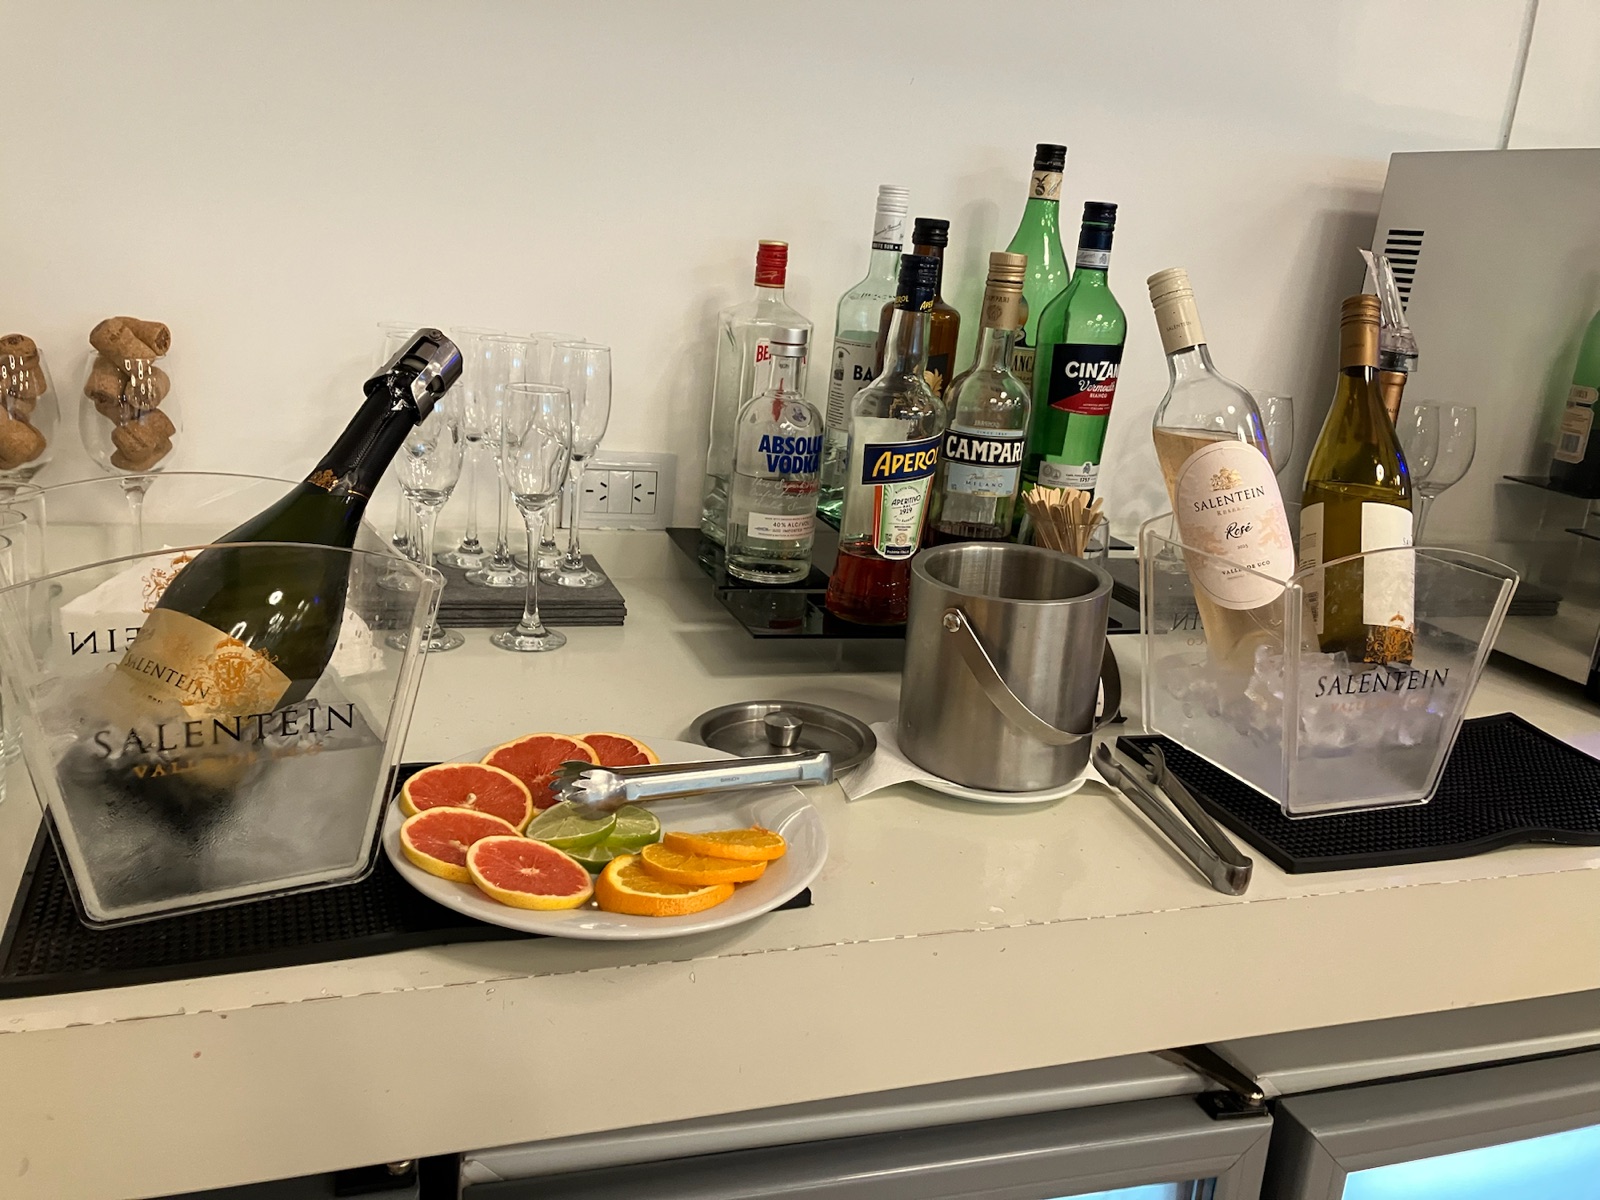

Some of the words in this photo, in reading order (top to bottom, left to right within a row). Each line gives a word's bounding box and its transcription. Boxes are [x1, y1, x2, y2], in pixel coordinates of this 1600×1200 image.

[1065, 361, 1121, 381] CINZAN
[758, 434, 823, 455] ABSOLU
[946, 435, 1025, 463] CAMPARI
[766, 454, 819, 473] VODKA
[965, 480, 1003, 488] MILANO
[891, 494, 921, 506] APERITIVO
[1193, 486, 1265, 512] SALENTEIN
[899, 507, 913, 515] 1919
[1225, 521, 1253, 540] Rosé
[124, 653, 212, 699] SALENTEIN
[1315, 668, 1450, 698] SALENTEIN
[94, 703, 355, 759] SALENTEIN
